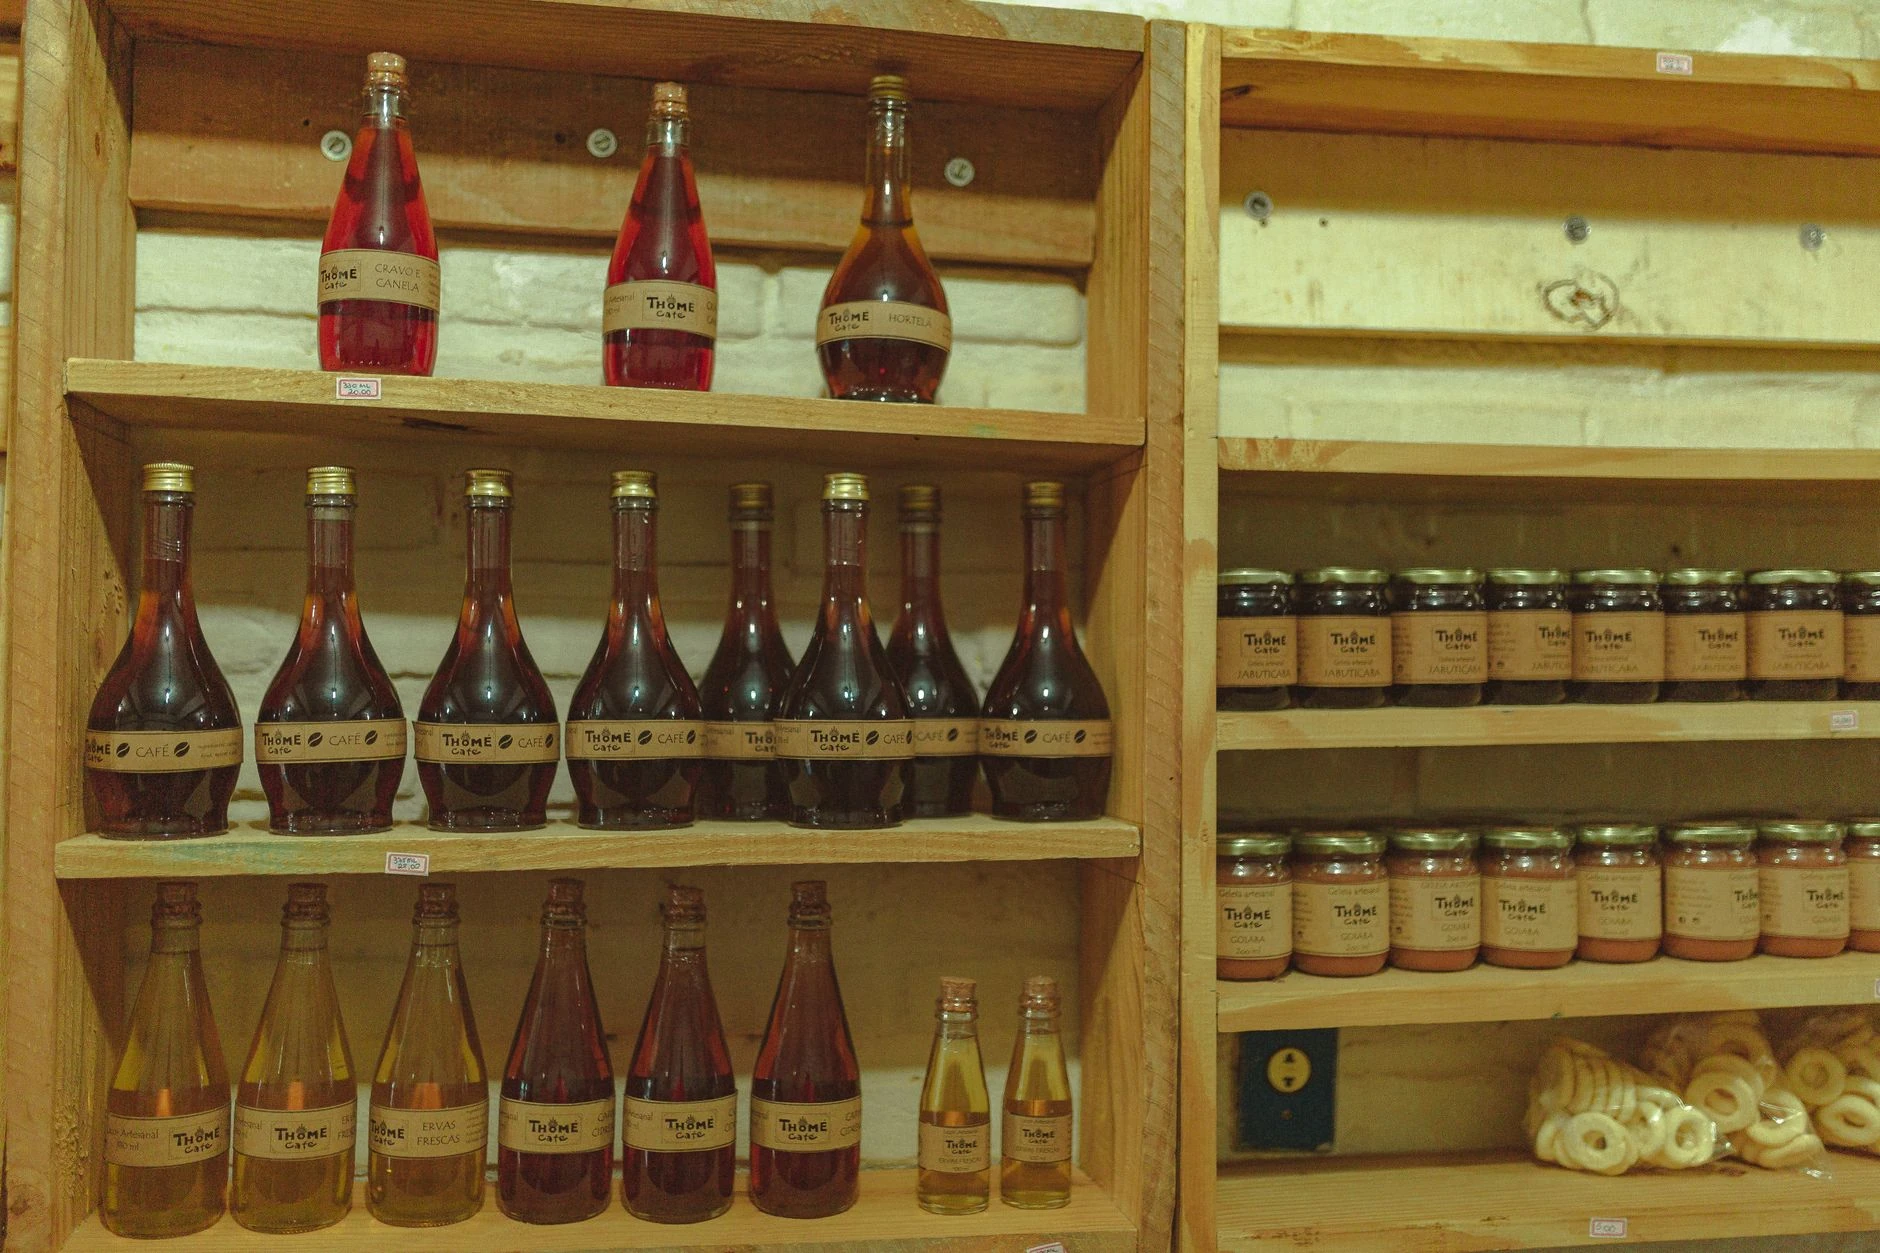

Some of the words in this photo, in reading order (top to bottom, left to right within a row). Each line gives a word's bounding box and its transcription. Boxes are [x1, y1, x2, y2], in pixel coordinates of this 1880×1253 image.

[374, 263, 413, 276] CRAVO
[375, 277, 420, 293] CANELA
[328, 733, 361, 746] CAFÉ
[518, 735, 543, 748] CAFÉ
[657, 732, 684, 744] CAFÉ
[883, 733, 905, 744] CAFÉ
[917, 730, 943, 742] CAFÉ
[1042, 730, 1071, 743] CAFÉ
[135, 743, 169, 757] CAFÉ
[422, 1120, 456, 1131] ERVAS
[416, 1134, 460, 1146] FRESCAS
